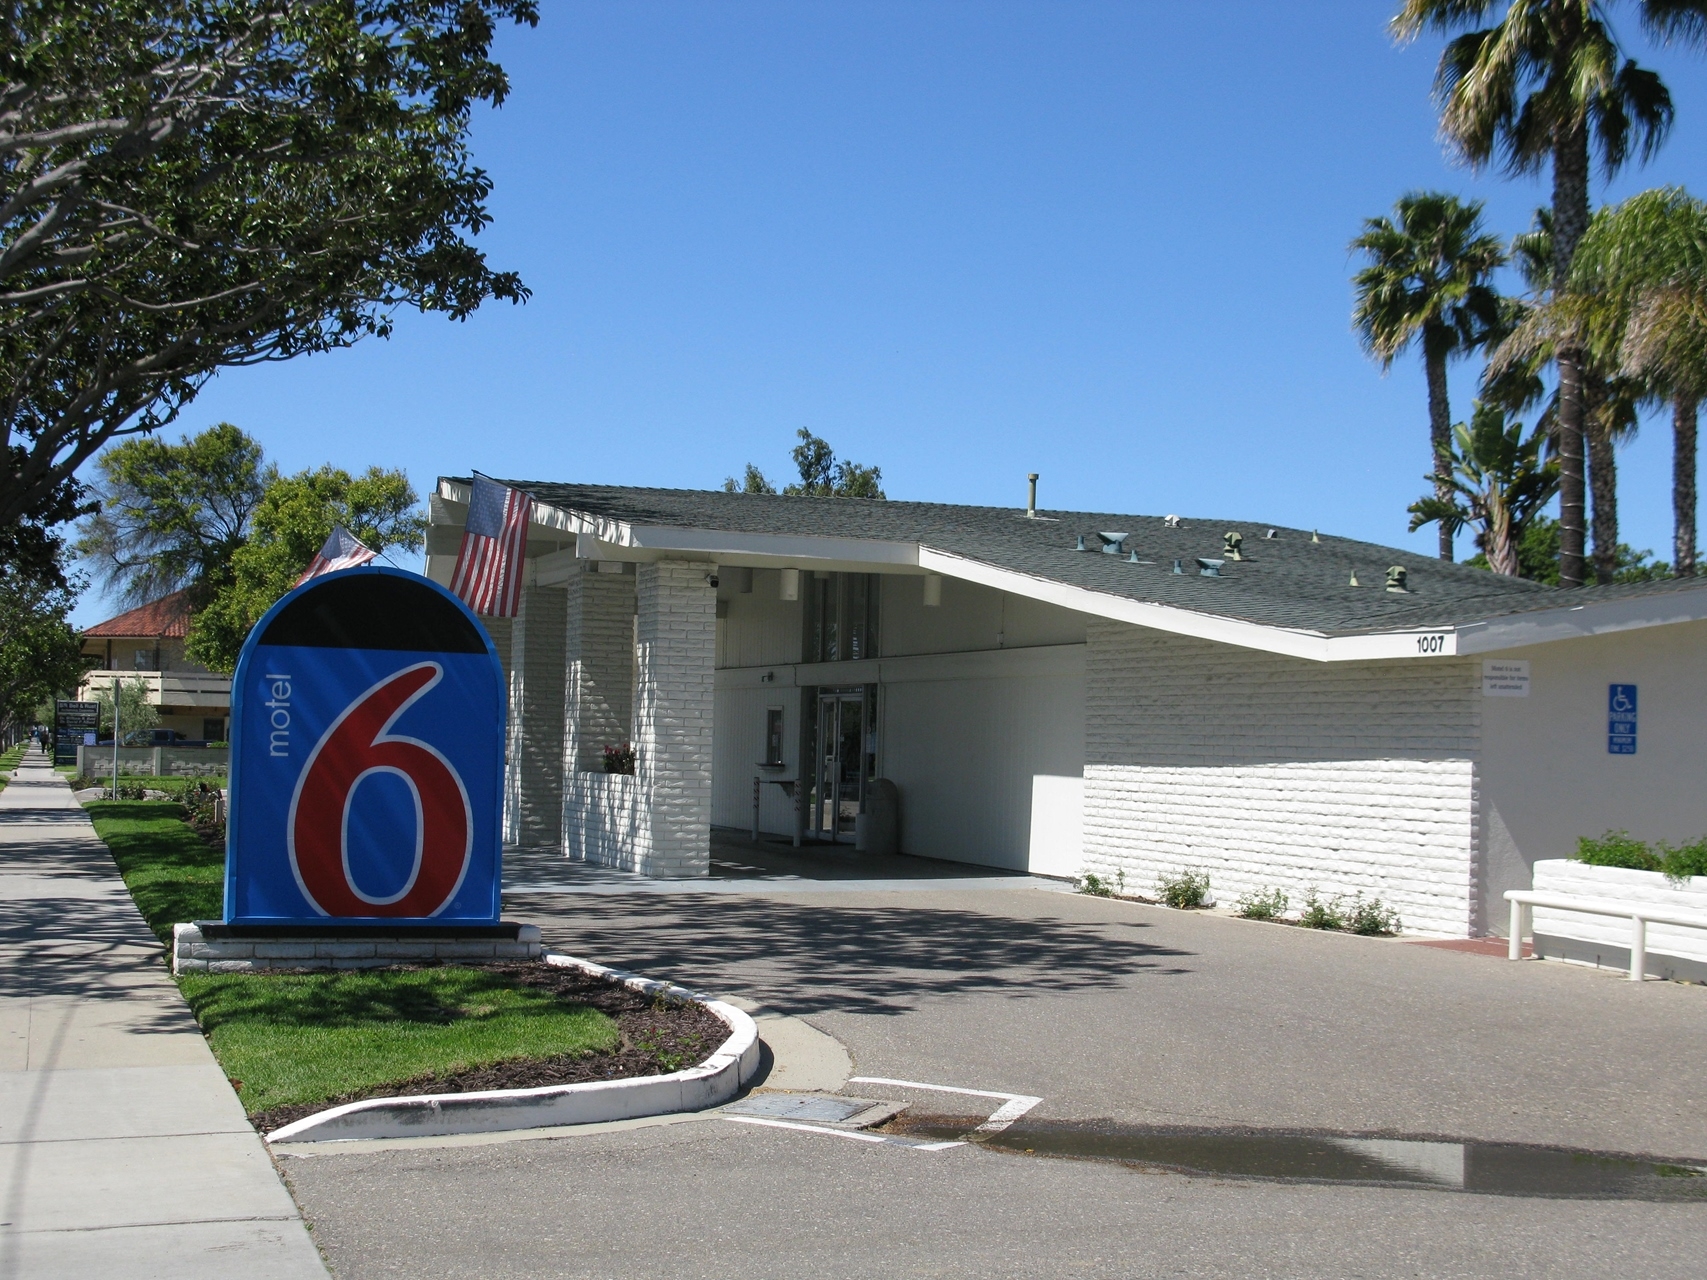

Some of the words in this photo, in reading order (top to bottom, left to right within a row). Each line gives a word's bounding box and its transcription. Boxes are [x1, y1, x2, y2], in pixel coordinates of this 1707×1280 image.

[1417, 635, 1445, 653] 1007
[264, 674, 292, 757] motel
[1609, 711, 1637, 722] PARKING
[1613, 722, 1631, 734] ONLY
[286, 660, 474, 917] 6
